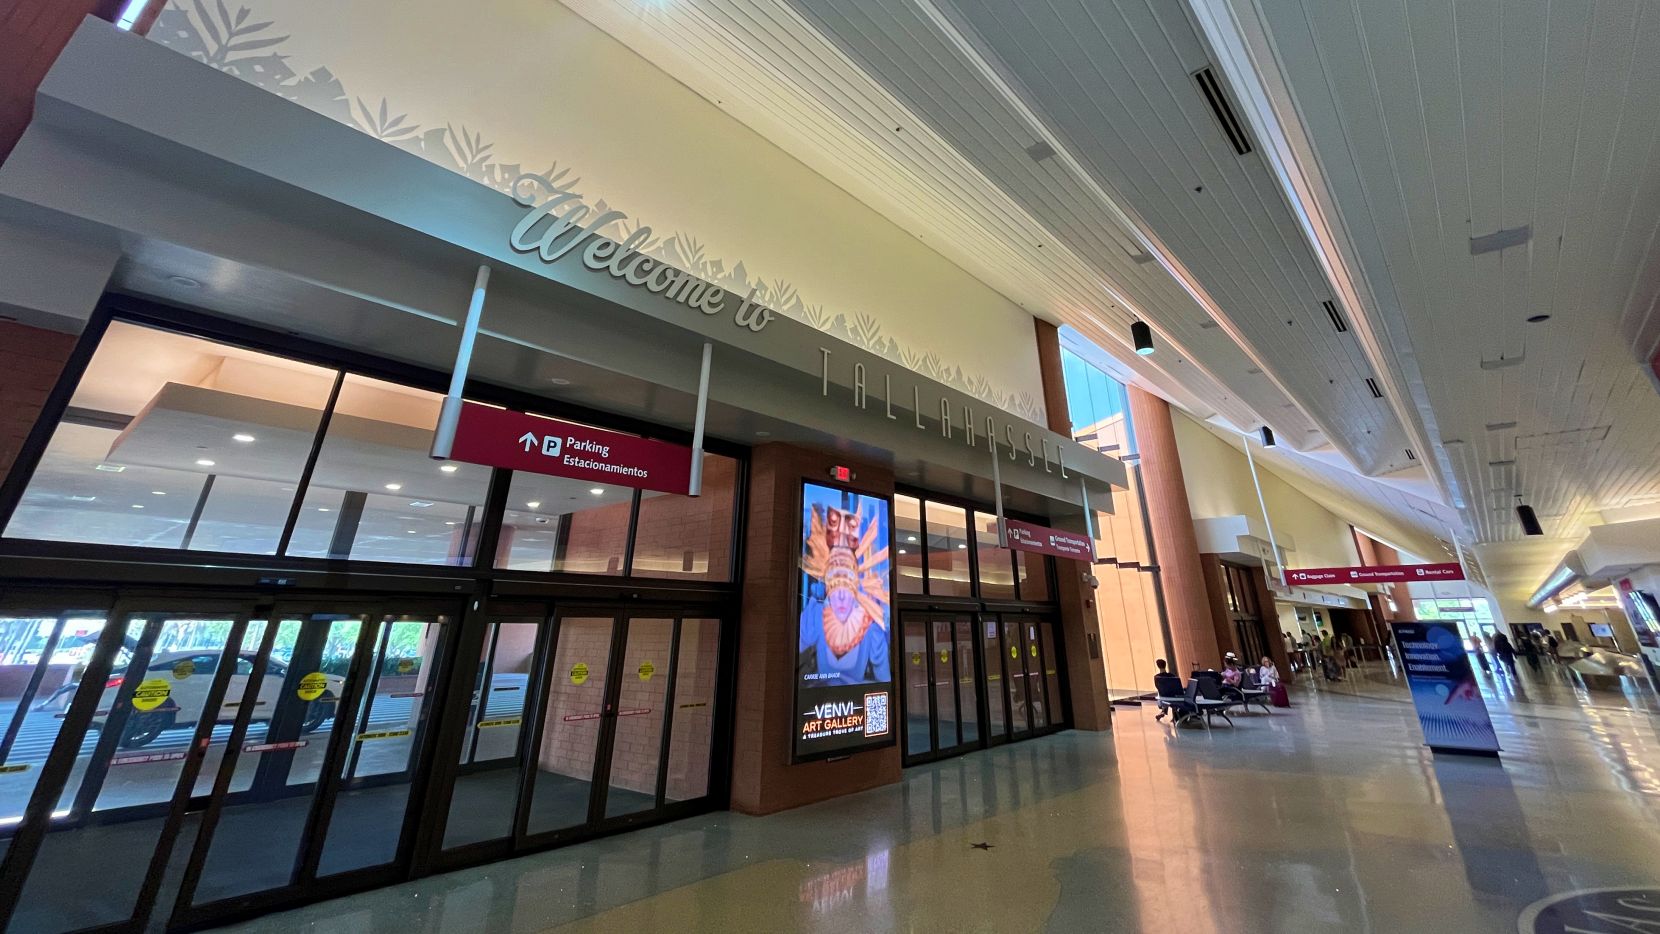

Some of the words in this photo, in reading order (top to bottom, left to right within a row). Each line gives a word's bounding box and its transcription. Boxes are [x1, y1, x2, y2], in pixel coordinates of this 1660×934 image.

[510, 172, 725, 316] Welcome
[734, 287, 775, 332] to
[820, 346, 1069, 479] TALLAHASSEE
[566, 437, 610, 457] Parking
[563, 455, 648, 478] Estacionamientos
[802, 720, 822, 733] ART
[824, 715, 864, 730] GALLERY
